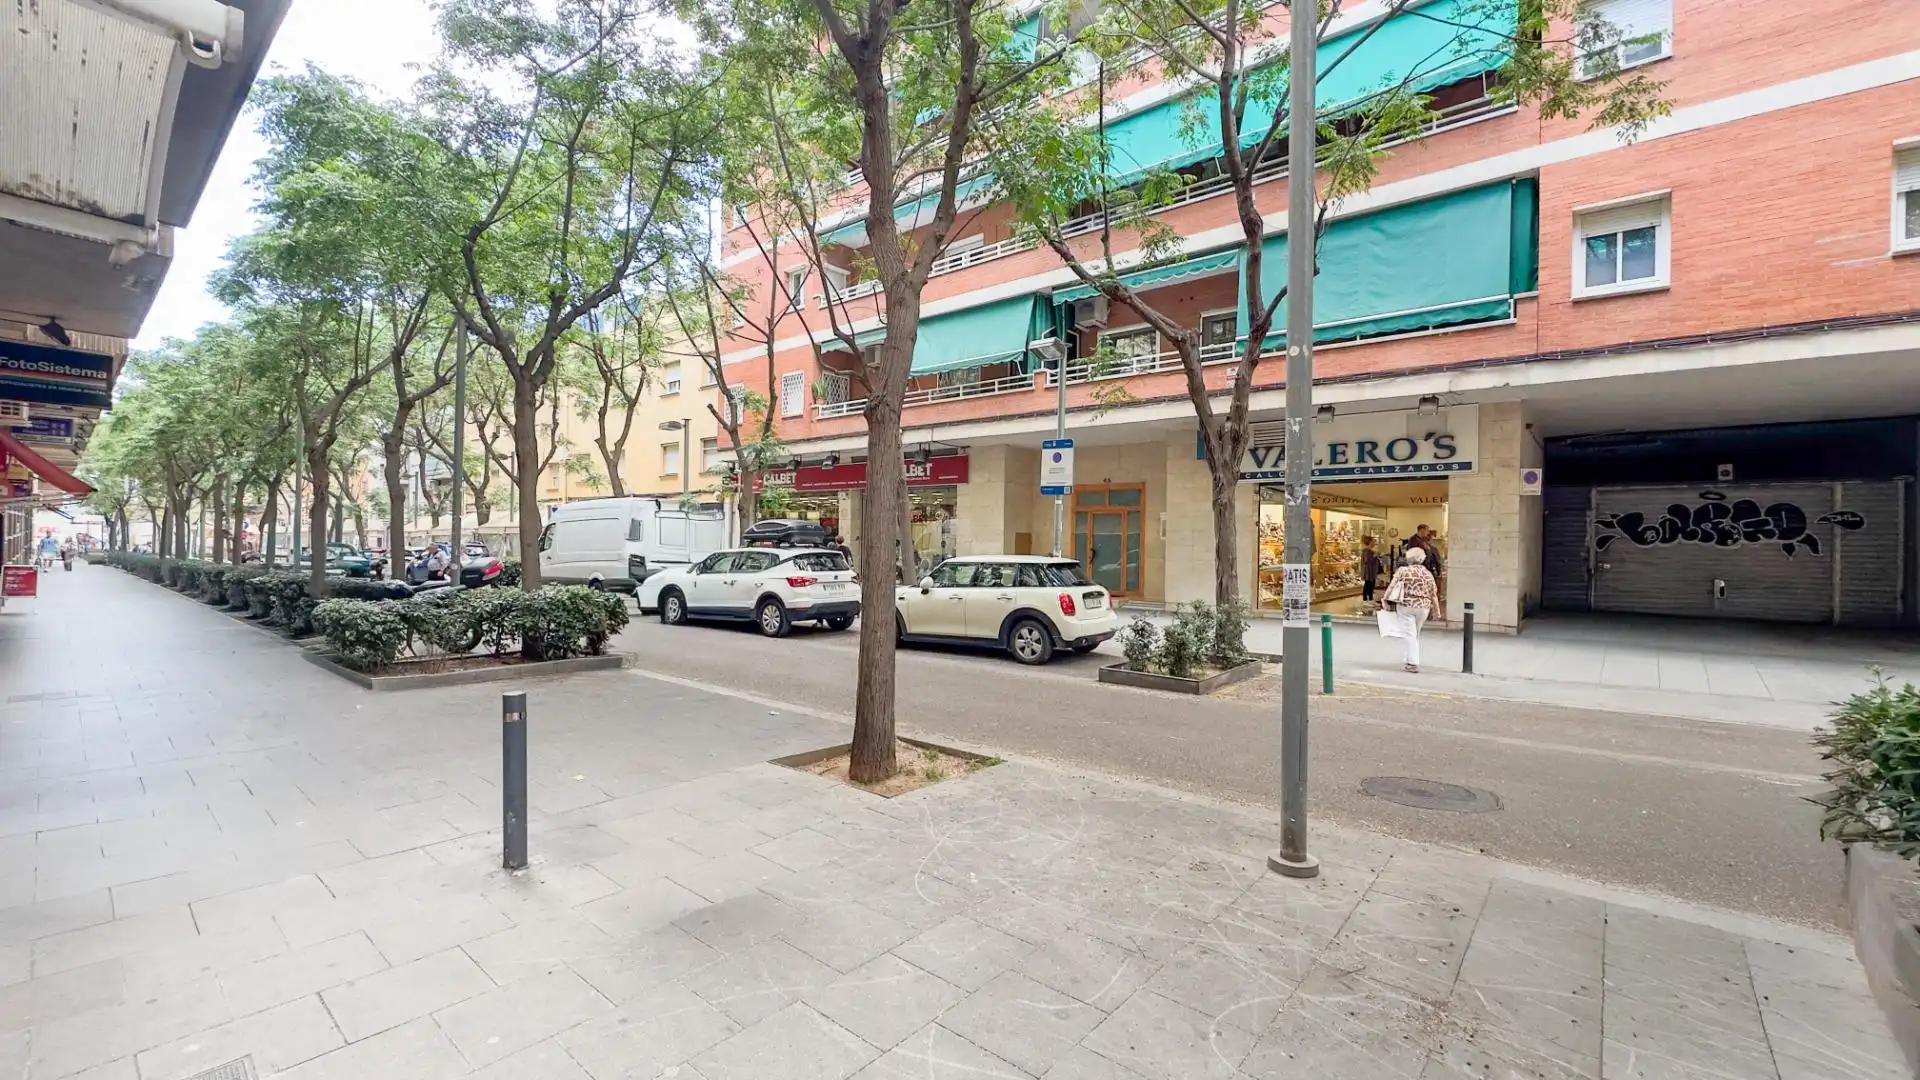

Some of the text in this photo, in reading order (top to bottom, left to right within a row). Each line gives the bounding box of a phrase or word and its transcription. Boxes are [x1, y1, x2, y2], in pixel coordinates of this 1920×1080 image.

[0, 356, 107, 379] FotoSistema
[1248, 432, 1457, 469] VERO'S
[904, 463, 933, 477] LBET
[1354, 463, 1459, 474] CALZADOS
[763, 472, 797, 485] CALBET
